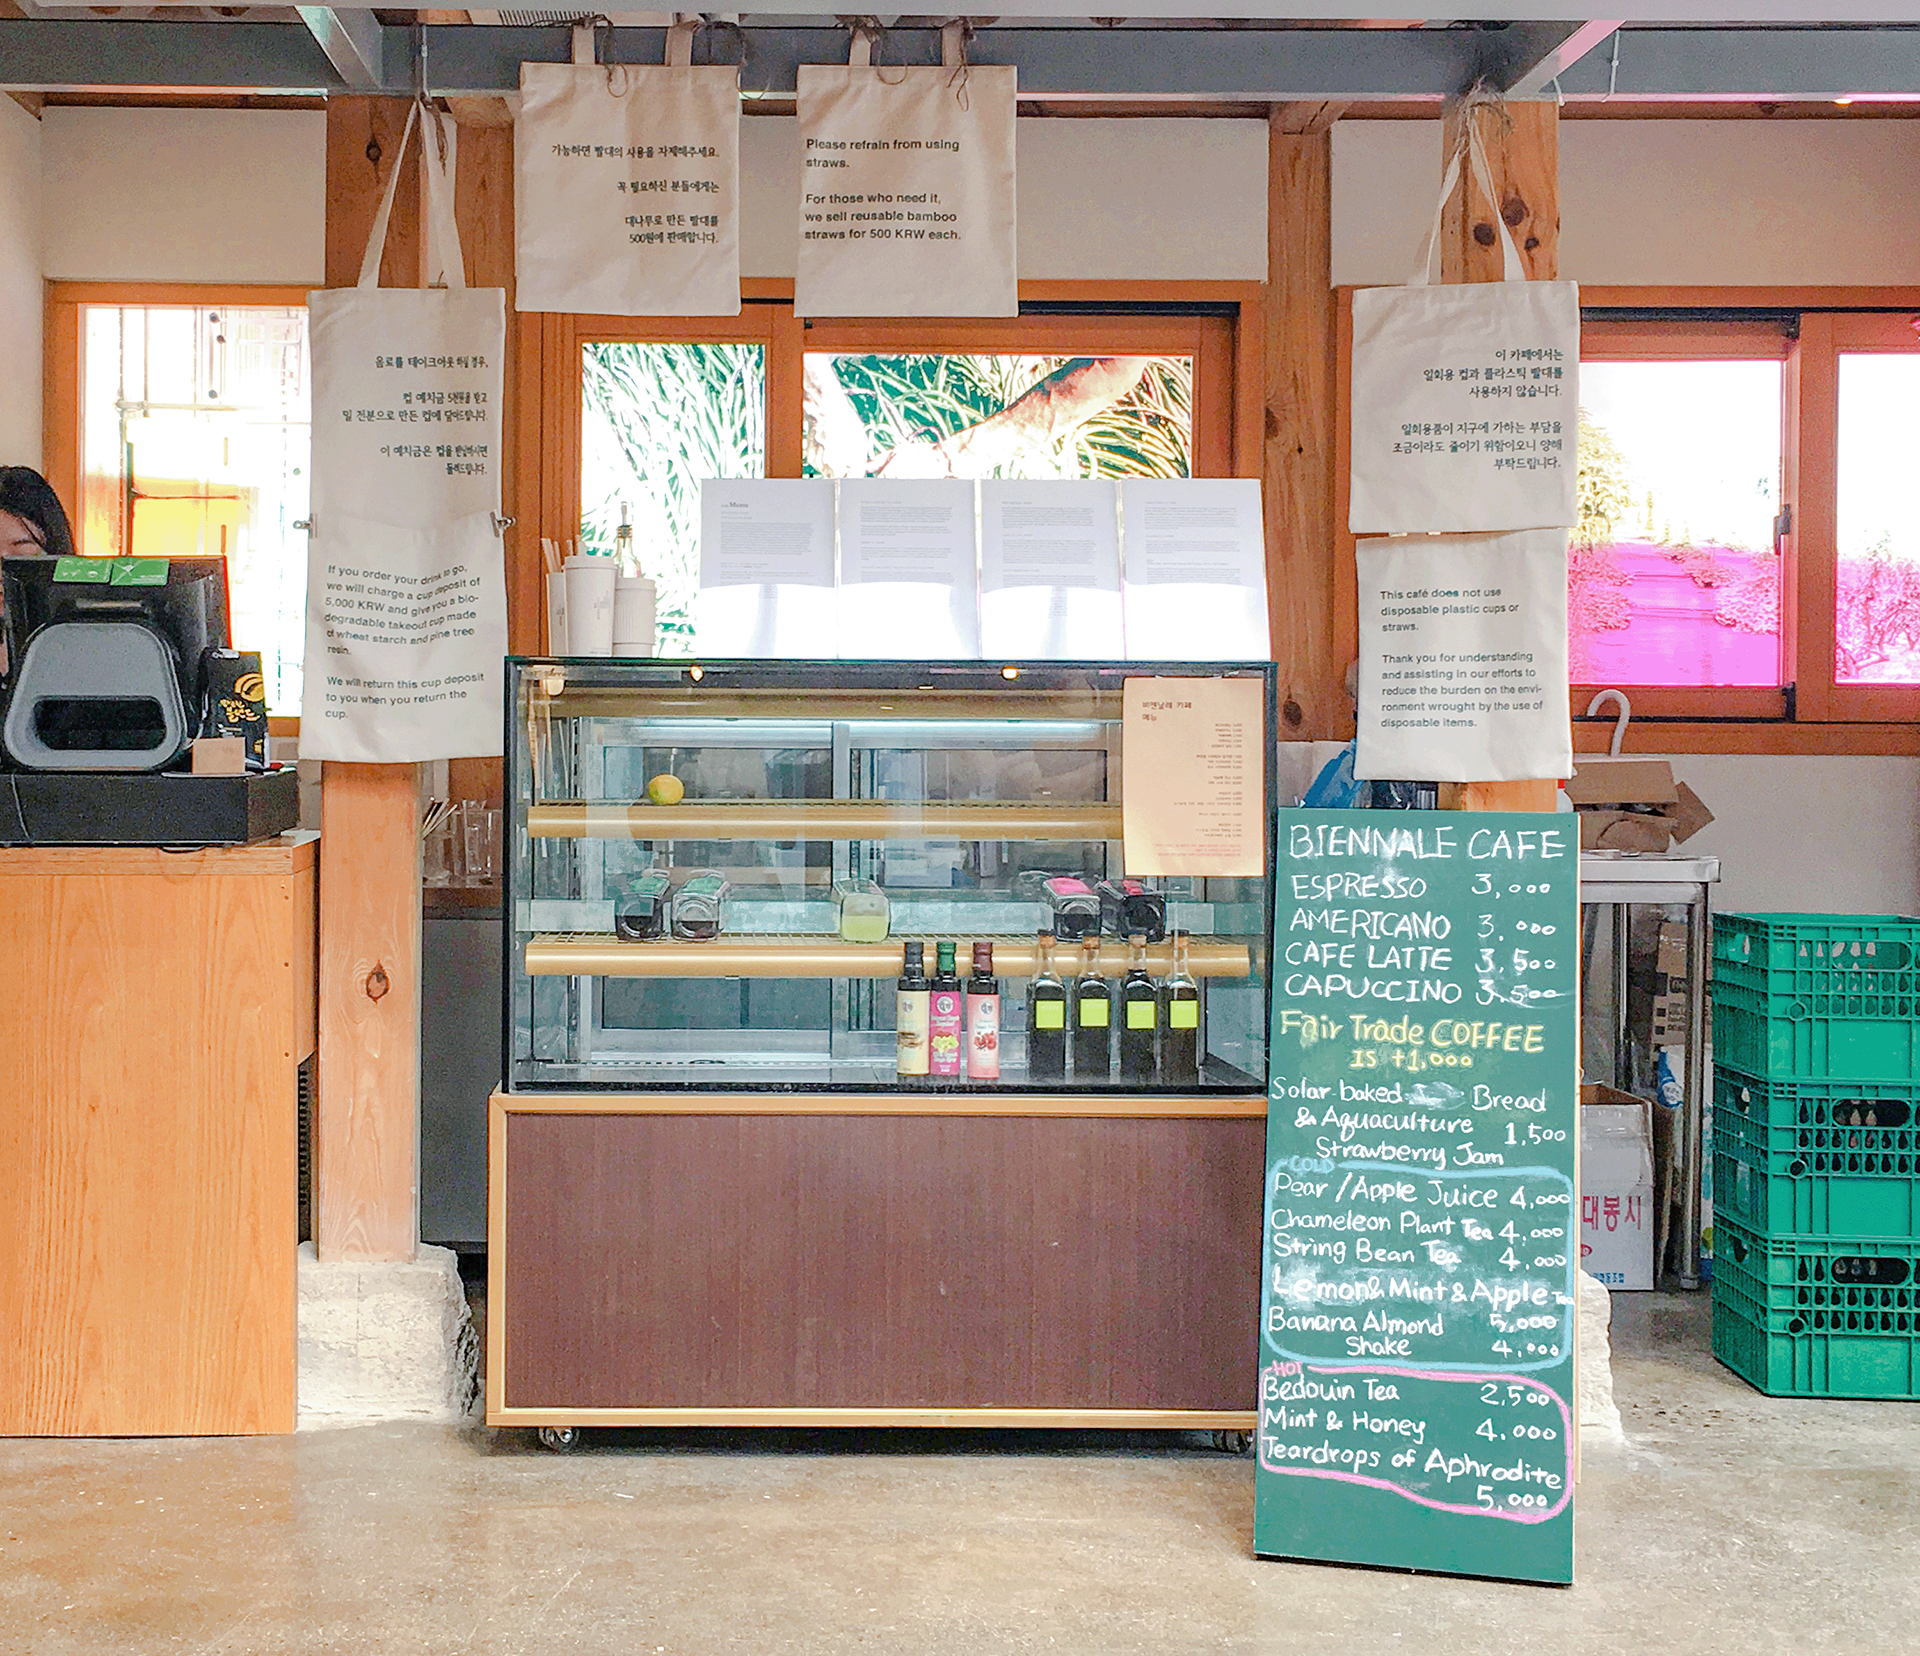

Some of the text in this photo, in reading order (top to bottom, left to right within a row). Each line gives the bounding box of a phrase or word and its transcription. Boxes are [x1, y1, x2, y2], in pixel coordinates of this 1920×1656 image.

[552, 144, 591, 157] 가능하면
[806, 138, 960, 152] Please refrain from using
[806, 158, 850, 168] straws.
[806, 193, 927, 204] For those who need
[625, 215, 663, 227] 대나무로
[805, 210, 957, 222] we sell reusable bamboo
[805, 229, 961, 240] straws for 500 KRW each.
[1495, 348, 1564, 361] 이 카페에서는
[1423, 366, 1563, 382] 일회용 컵과 플라스틱 빨대를
[1469, 384, 1562, 399] 사용하지 않습니다.
[1401, 420, 1562, 436] 일회용품이 지구에 가하는 부담을
[1392, 439, 1536, 454] 조금이라도 줄이기 위함이오니
[1494, 456, 1561, 470] 부탁드립니다.
[338, 567, 418, 586] you order your
[367, 585, 405, 600] charge
[1380, 589, 1481, 600] This does not
[357, 600, 408, 615] KRW and
[1380, 604, 1506, 617] disposable plastic cups
[324, 610, 477, 631] degradable takeout made
[1381, 623, 1419, 632] straws.
[336, 630, 407, 645] wheat starch
[1381, 651, 1534, 665] Thank you for understanding
[326, 672, 484, 689] We return this deposit
[1381, 668, 1523, 681] and assisting efforts
[413, 692, 447, 704] return
[1381, 685, 1481, 696] reduce the burden
[1381, 701, 1476, 713] ronment wrought
[1380, 718, 1477, 730] disposable items.
[1289, 825, 1566, 860] BIENNALE CAFE
[1291, 872, 1551, 902] ESPRESSO 3,000
[1289, 907, 1452, 940] AMERICANO
[1285, 941, 1355, 968] CAFE
[1367, 944, 1453, 972] LATTE
[1284, 973, 1463, 1005] CAPUCCINO
[1280, 1009, 1545, 1053] Fair Trade COFFEE
[1350, 1049, 1473, 1072] IS +1,000
[1471, 1084, 1547, 1113] Bread
[1294, 1105, 1567, 1146] & Aquaculture 1,500
[1315, 1136, 1504, 1170] Strawberry Jam
[1288, 1156, 1335, 1173] COLD
[1273, 1172, 1329, 1200] Pear
[1427, 1180, 1499, 1208] Juice
[1509, 1185, 1571, 1210] 4,000
[1270, 1209, 1392, 1231] Chameleon
[1400, 1211, 1456, 1236] Plant
[1460, 1218, 1494, 1240] Tea
[1273, 1232, 1567, 1272] String Bean Tea 4,000
[1388, 1276, 1449, 1302] Mint
[1450, 1283, 1468, 1303] &
[1469, 1279, 1548, 1313] Apple
[1550, 1290, 1576, 1306] Tea
[1268, 1305, 1358, 1333] Banana
[1362, 1309, 1444, 1337] Almond
[1345, 1335, 1412, 1357] Shake
[1272, 1359, 1303, 1376] HOT
[1262, 1372, 1355, 1402] Bedouin
[1362, 1378, 1401, 1401] Tea
[1264, 1407, 1318, 1430] Mint
[1325, 1412, 1344, 1430] &
[1352, 1410, 1426, 1445] Honey
[1262, 1436, 1562, 1490] Teardrops of Aphrodite
[1476, 1484, 1548, 1513] 5,000
